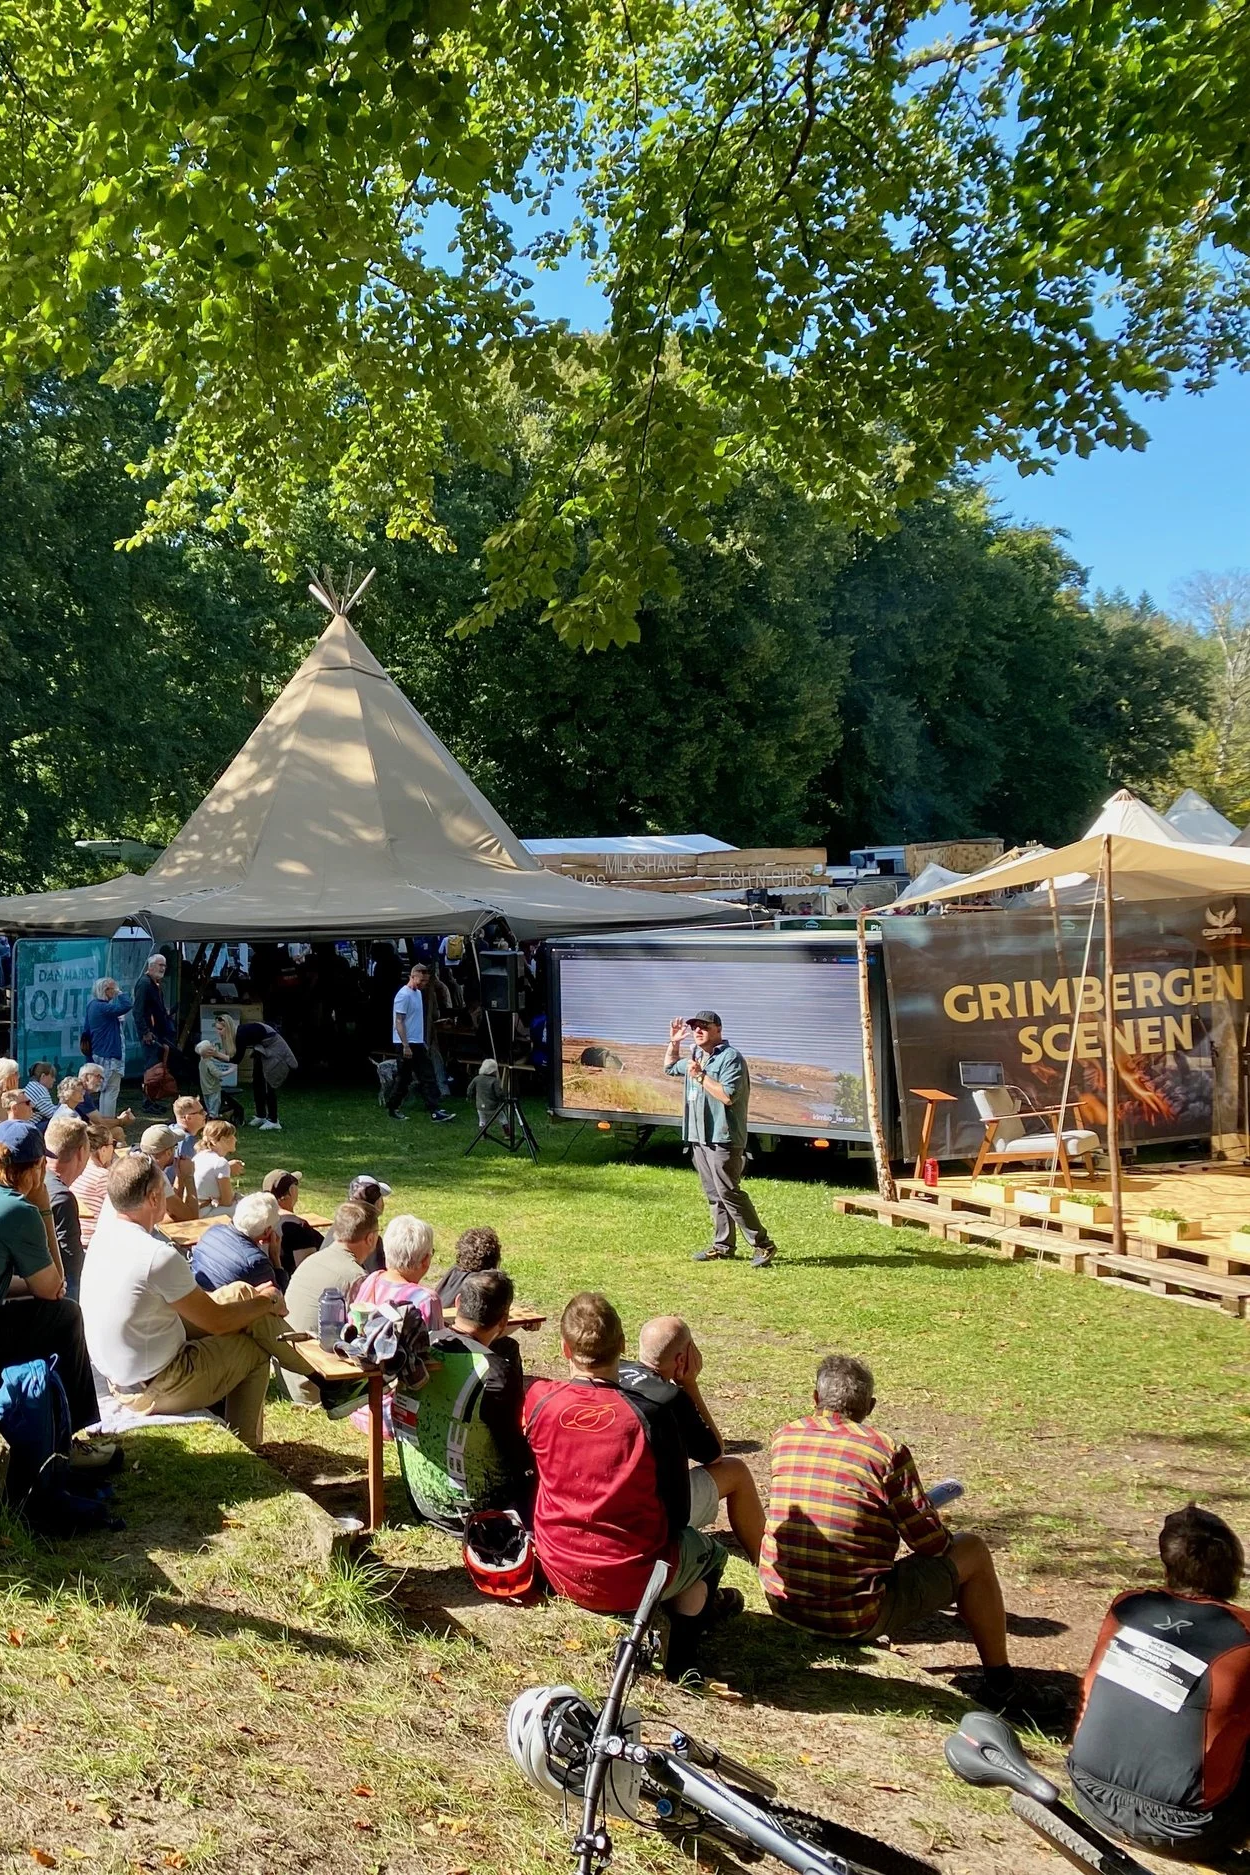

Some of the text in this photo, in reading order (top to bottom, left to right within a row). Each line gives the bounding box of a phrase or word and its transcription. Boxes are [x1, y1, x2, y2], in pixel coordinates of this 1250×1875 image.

[605, 854, 686, 874] MILKSHAKE
[719, 867, 812, 889] FISH N CHIPS
[38, 967, 95, 983] DANMARKS
[943, 964, 1244, 1023] GRIMBERGEN
[1017, 1014, 1194, 1064] SCENEN
[1131, 1647, 1172, 1670] DENNIS
